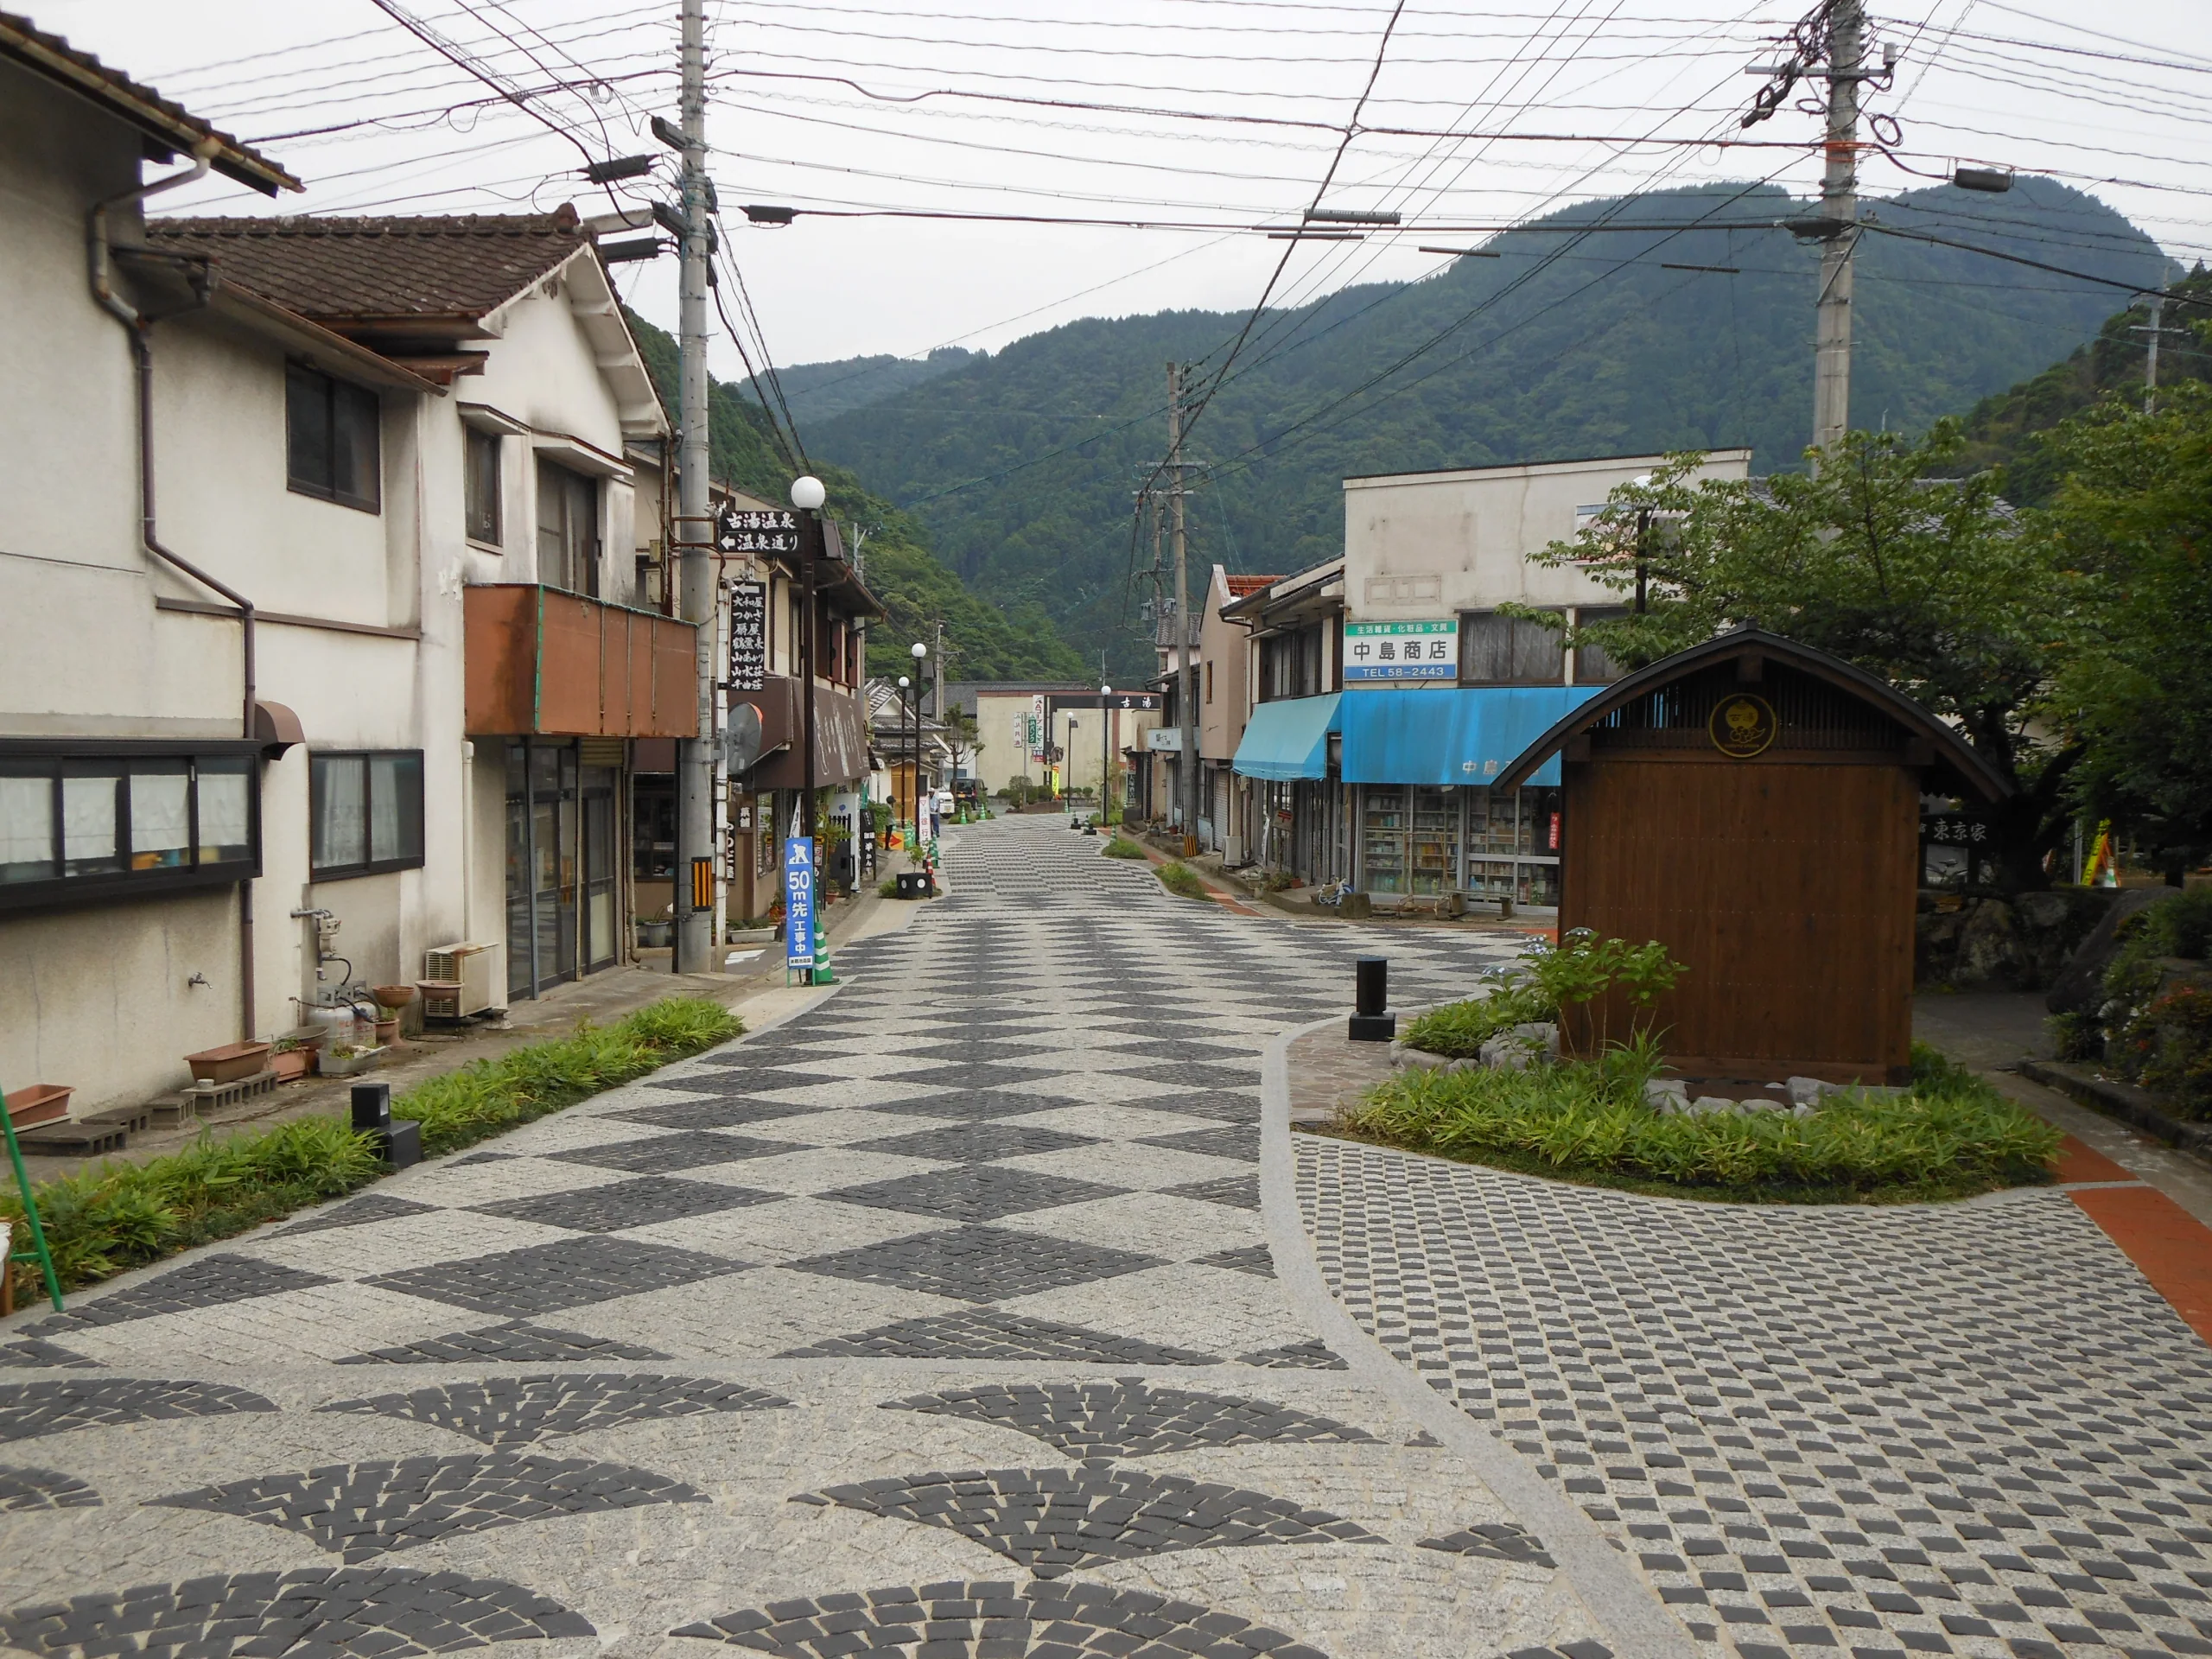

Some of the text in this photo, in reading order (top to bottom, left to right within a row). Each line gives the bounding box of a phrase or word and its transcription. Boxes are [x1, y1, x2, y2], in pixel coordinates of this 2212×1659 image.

[727, 512, 796, 529] 古湯温泉
[737, 533, 798, 550] 温泉通り
[733, 596, 764, 607] 大和屋
[733, 608, 762, 621] つかさ
[1354, 640, 1446, 661] 中島商店
[731, 665, 764, 677] 山水荘
[1363, 667, 1444, 677] TEL 58-2443
[1121, 696, 1152, 709] 古湯
[1934, 818, 1986, 842] 東京家
